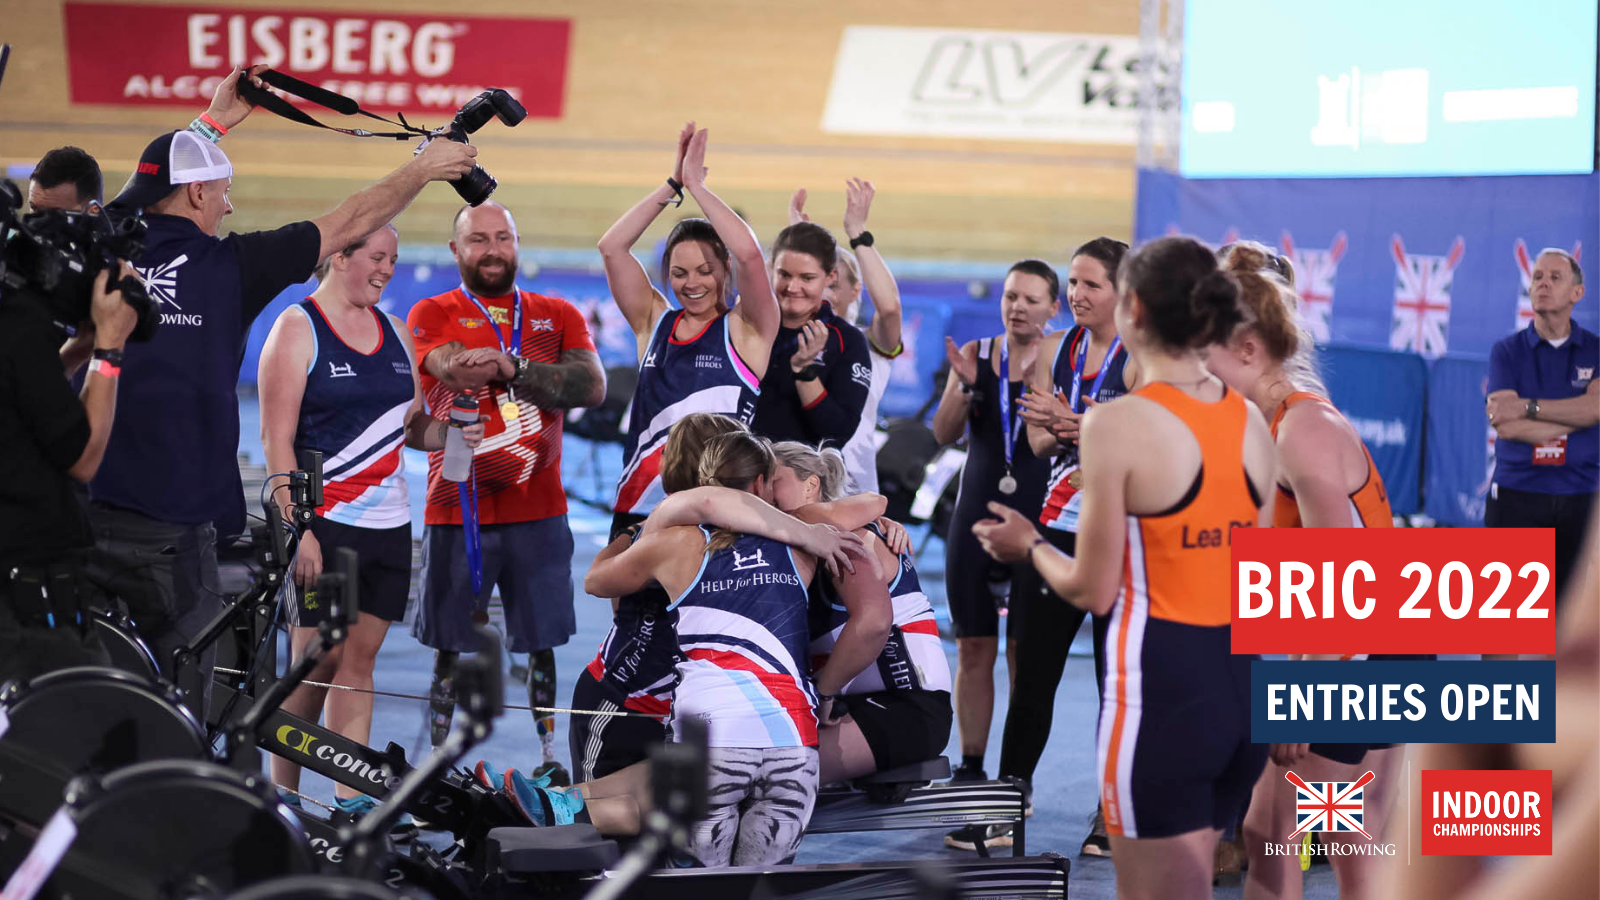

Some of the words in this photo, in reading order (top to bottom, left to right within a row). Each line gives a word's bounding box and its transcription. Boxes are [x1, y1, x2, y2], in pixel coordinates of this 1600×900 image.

[187, 13, 458, 78] EISBERG
[910, 35, 1088, 108] LV
[1182, 525, 1222, 549] Lea
[701, 579, 734, 594] HELP
[734, 577, 752, 591] for
[753, 572, 799, 586] HEROES
[625, 649, 642, 675] for
